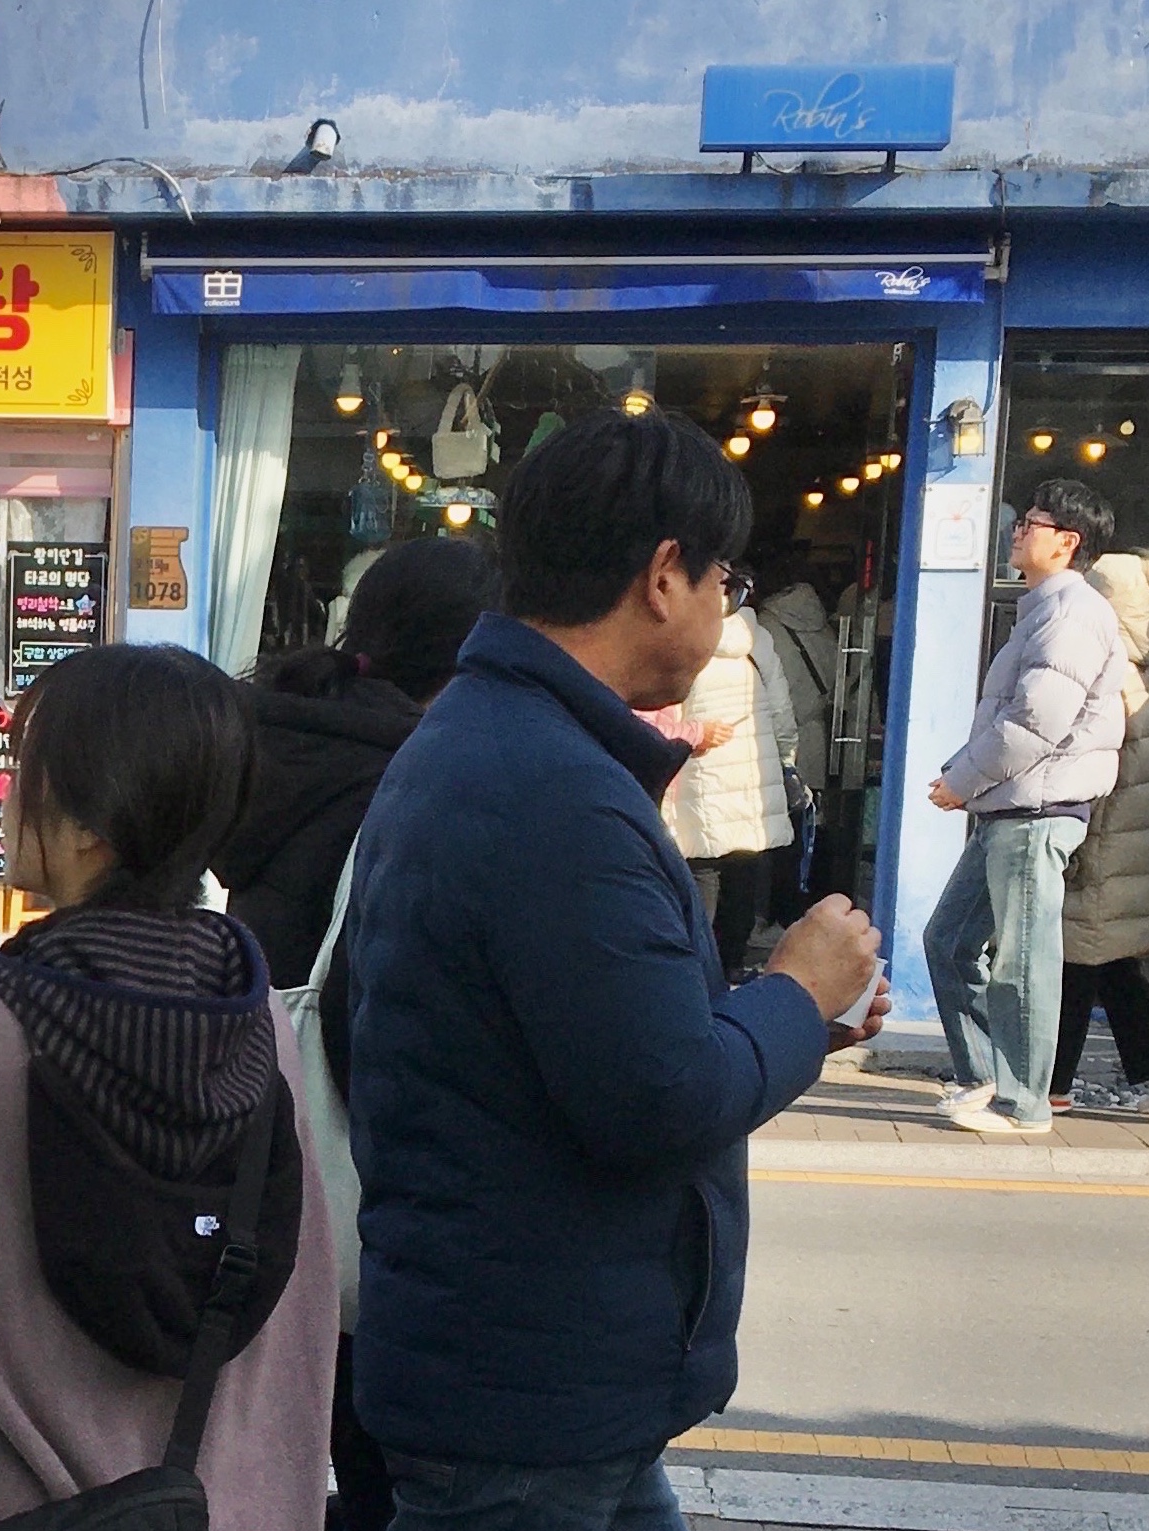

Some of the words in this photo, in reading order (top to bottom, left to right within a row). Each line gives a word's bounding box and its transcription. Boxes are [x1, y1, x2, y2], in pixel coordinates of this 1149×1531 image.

[763, 72, 876, 138] Robin's
[24, 570, 62, 586] 타로의
[64, 571, 91, 588] 명당
[133, 581, 182, 602] 1078
